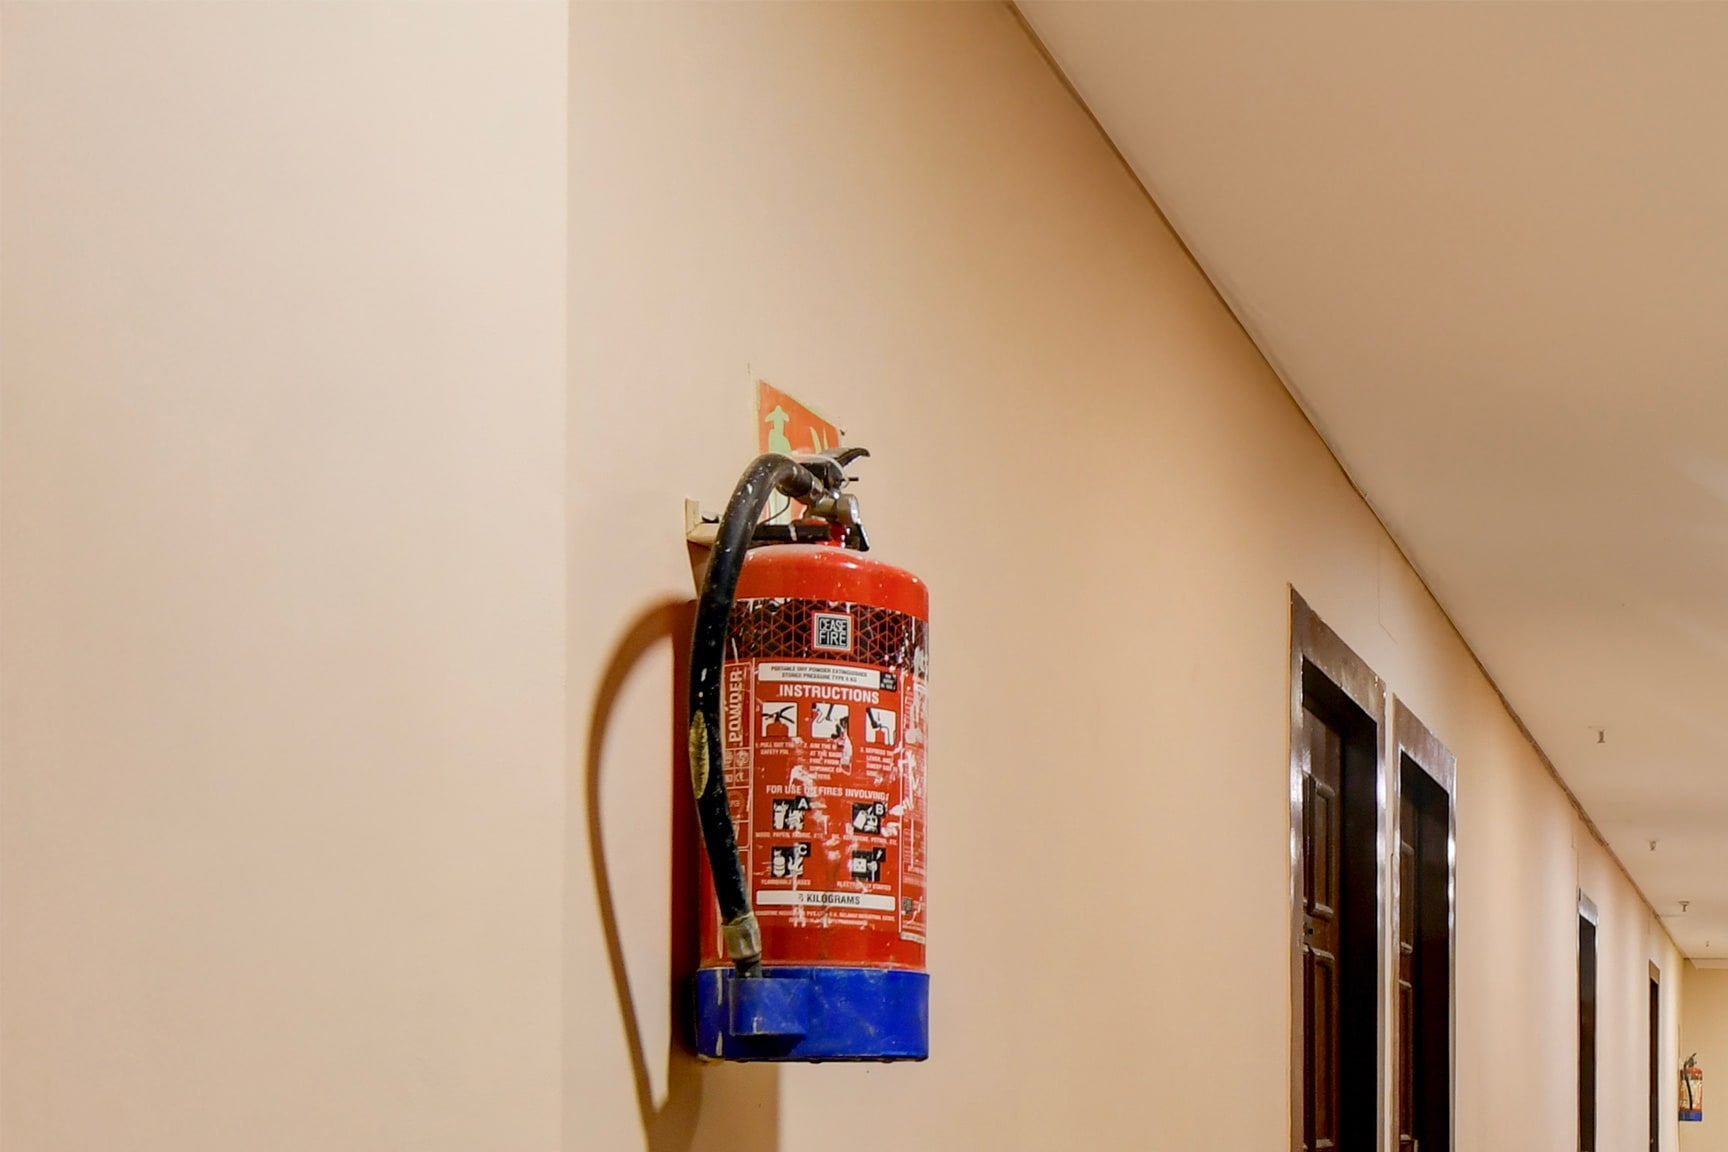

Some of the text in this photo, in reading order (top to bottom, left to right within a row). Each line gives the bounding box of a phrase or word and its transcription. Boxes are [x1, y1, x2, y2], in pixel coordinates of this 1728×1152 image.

[819, 618, 847, 632] CEASE
[819, 631, 847, 646] FIRE
[779, 684, 880, 704] INSTRUCTIONS
[729, 669, 744, 743] POWDER
[766, 785, 782, 795] FOR
[785, 785, 801, 794] USE
[819, 786, 842, 796] FIRES
[798, 797, 808, 809] A
[875, 803, 884, 815] B
[799, 844, 808, 855] C
[806, 893, 861, 905] KILOGRAMS
